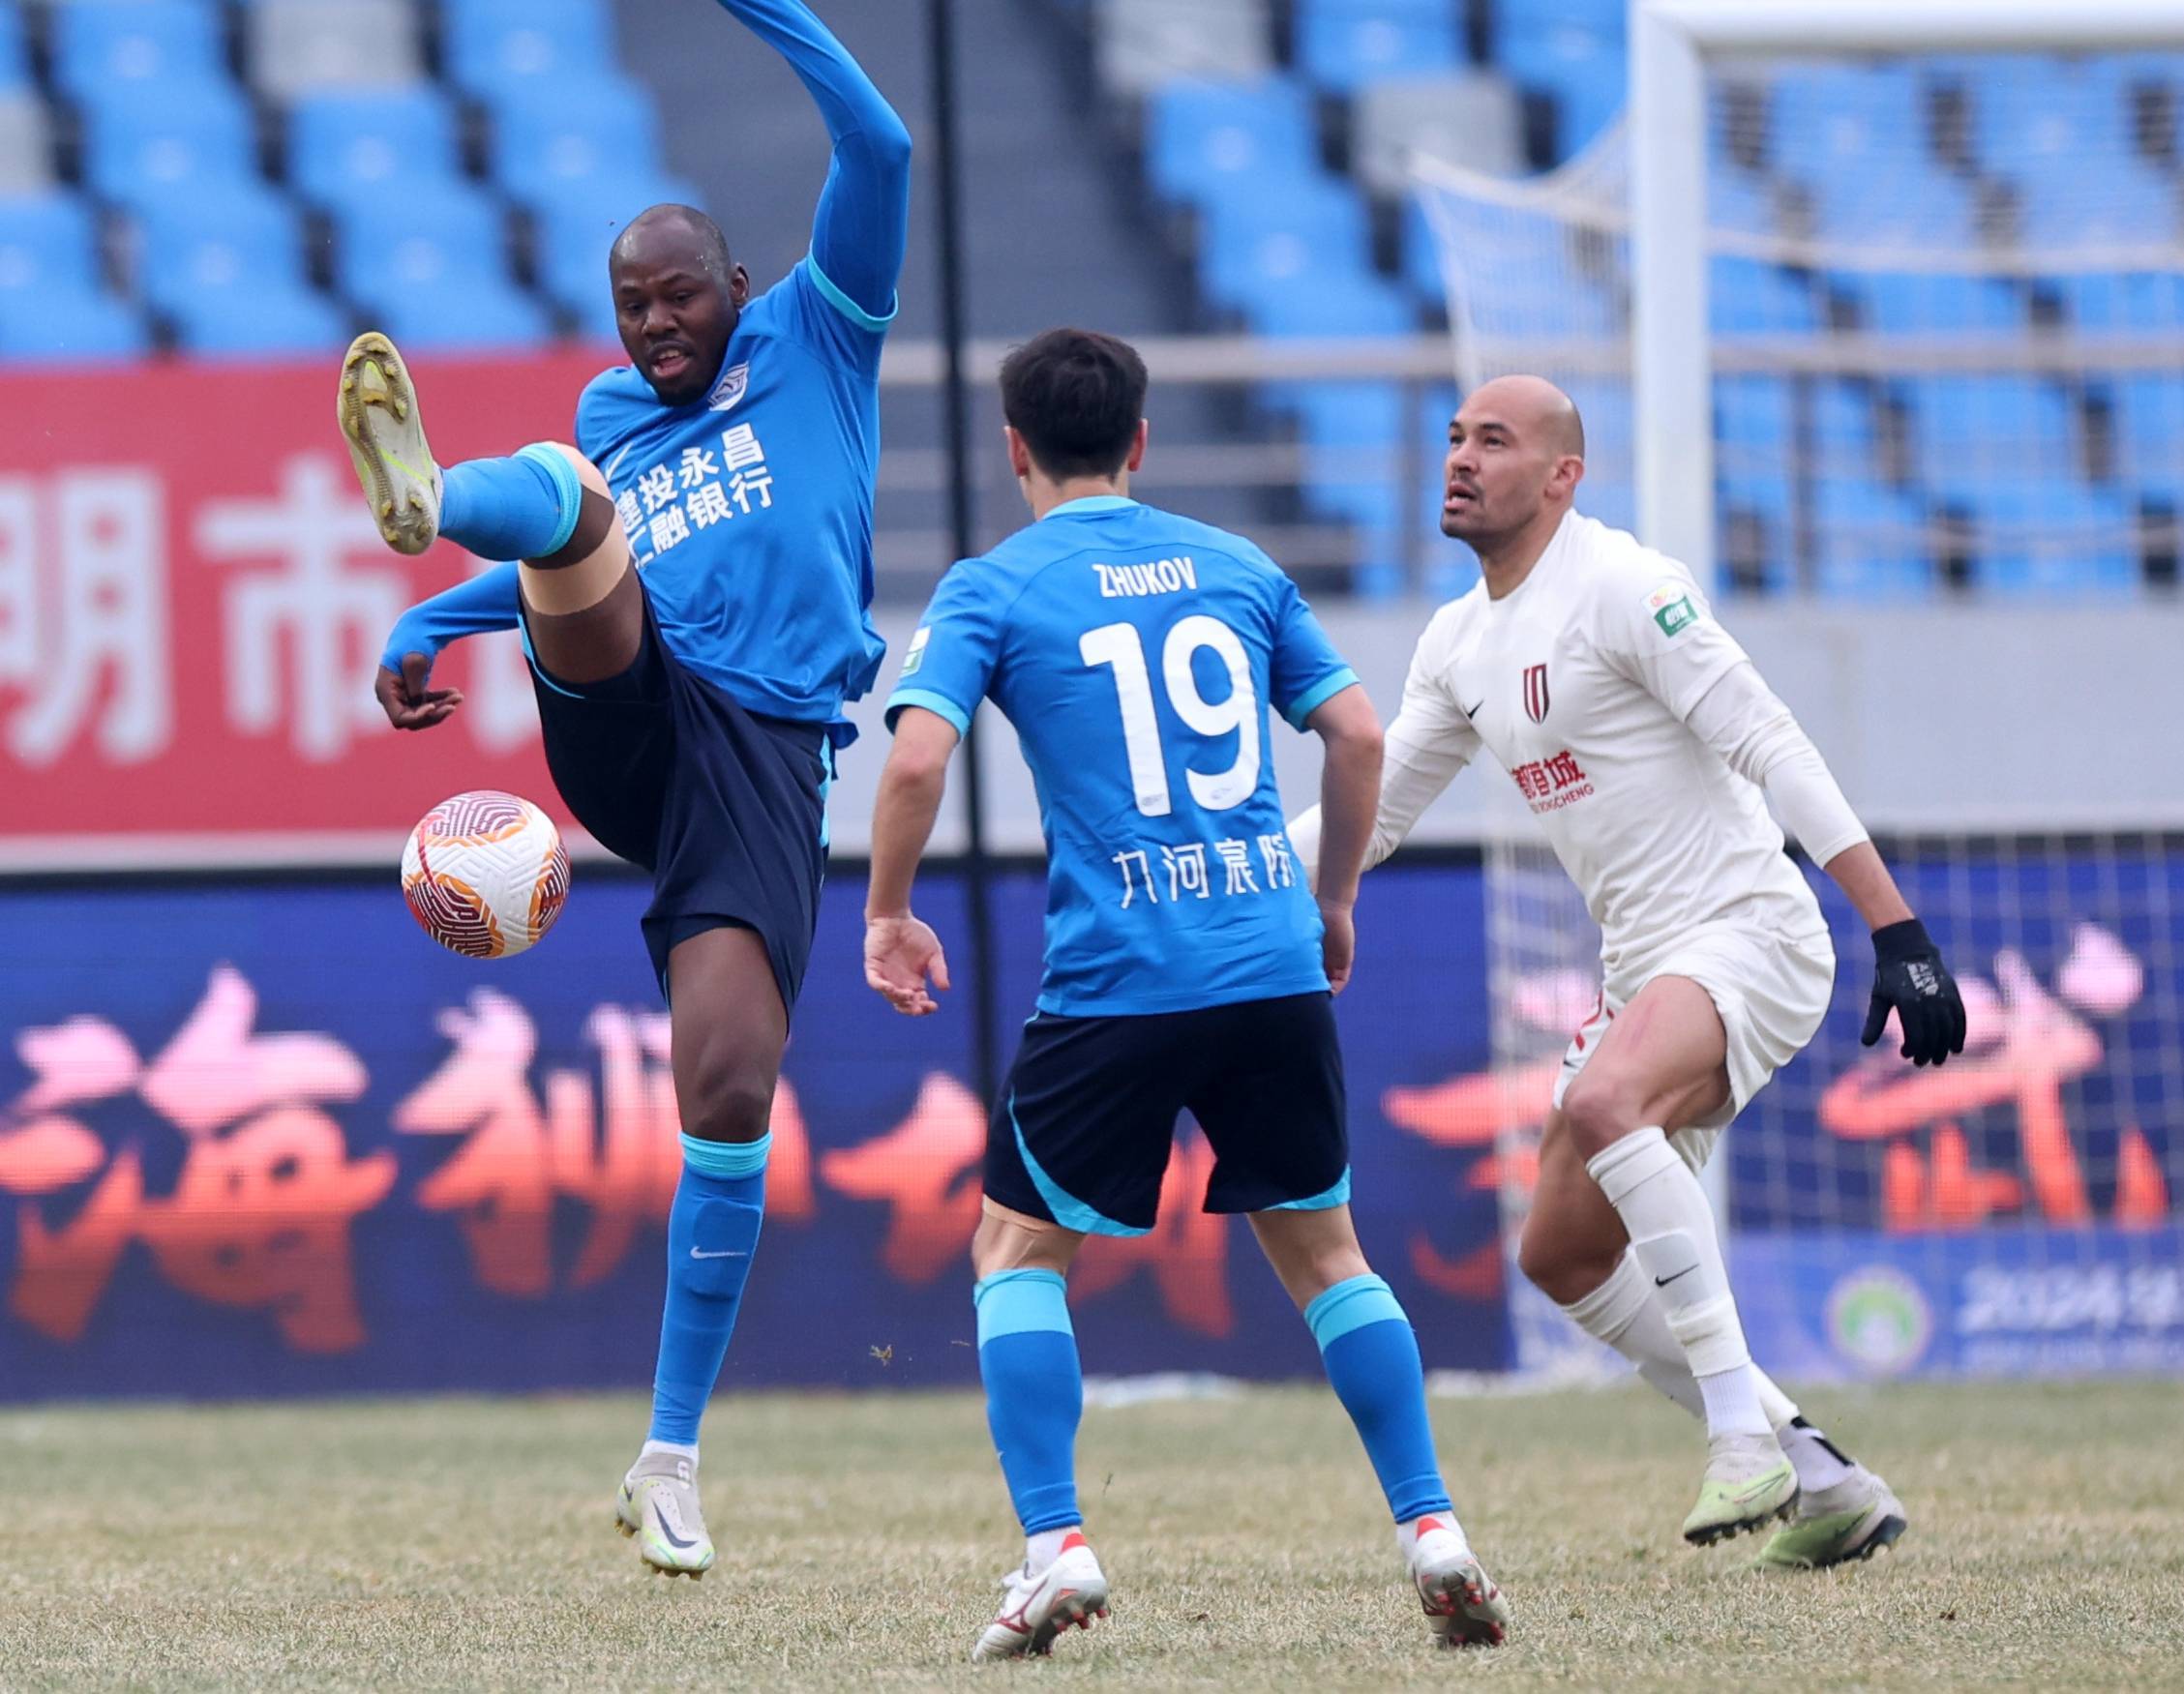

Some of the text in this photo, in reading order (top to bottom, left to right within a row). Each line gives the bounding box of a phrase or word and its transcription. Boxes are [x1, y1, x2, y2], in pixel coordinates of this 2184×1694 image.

[0, 451, 538, 766] 明市
[1092, 556, 1198, 598] ZHUKOV
[1078, 614, 1261, 817] 19
